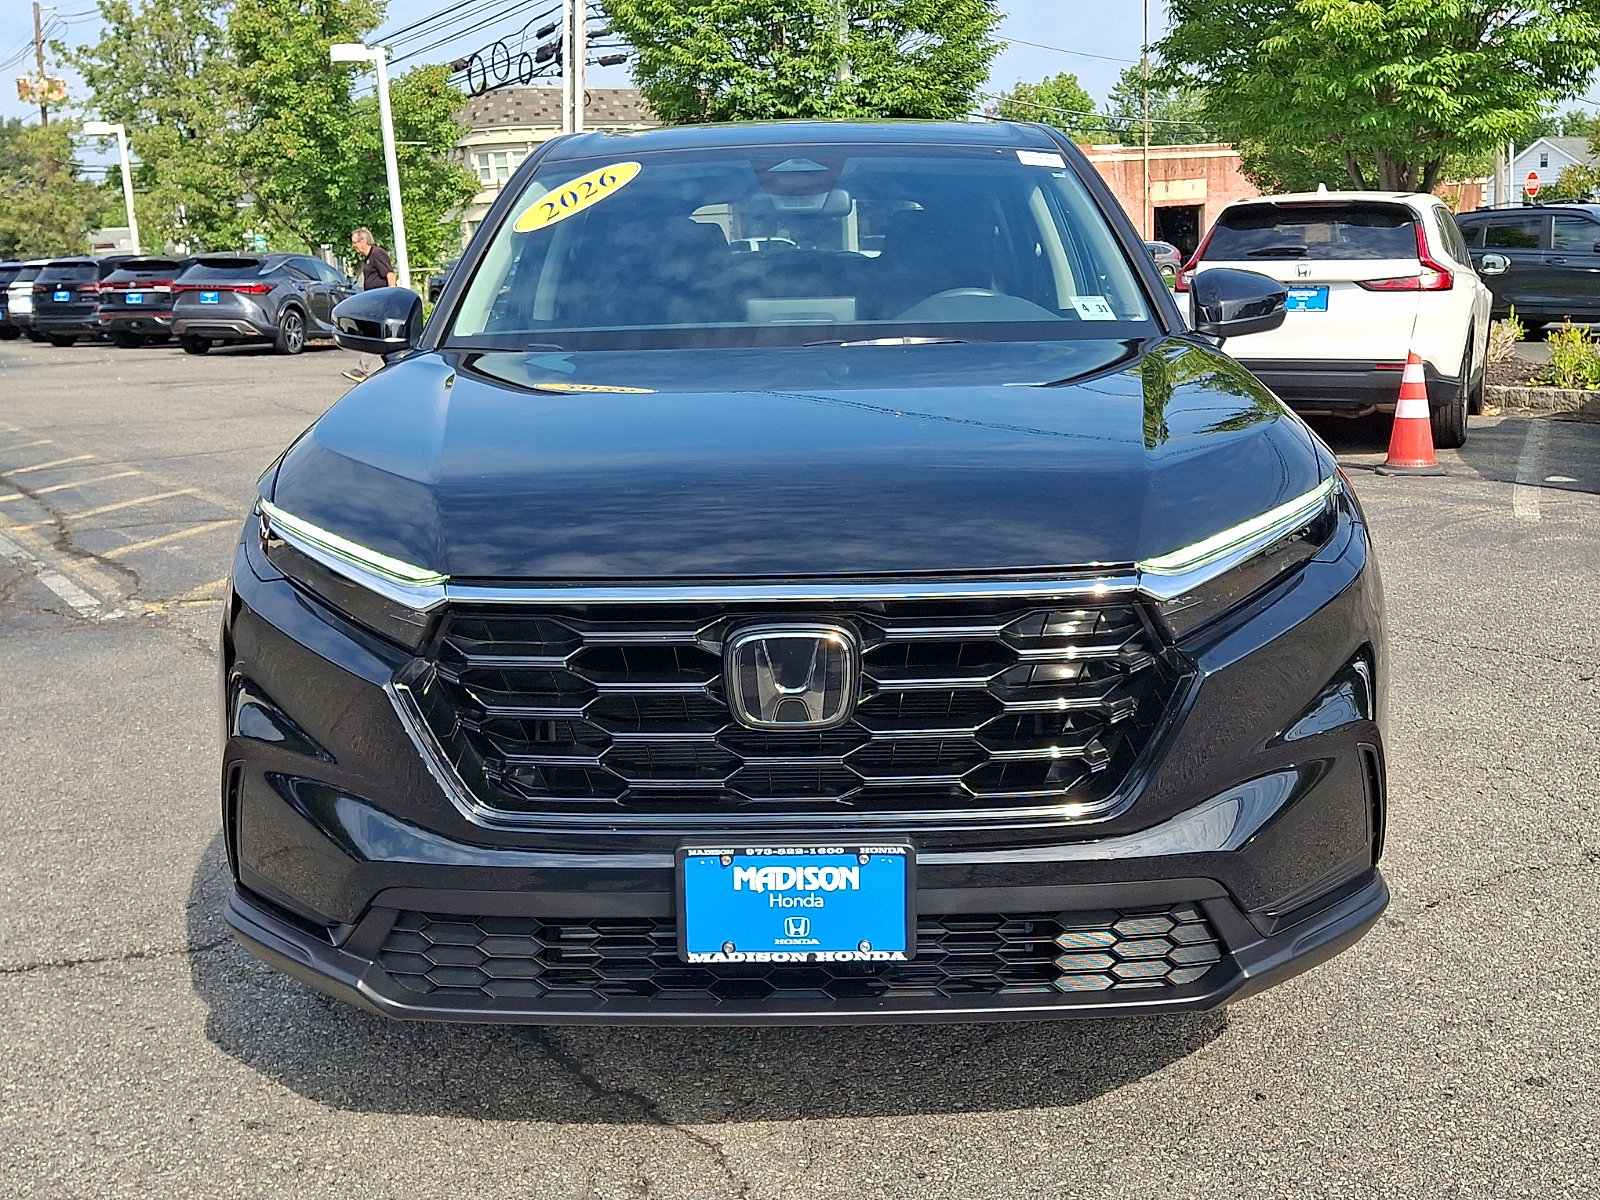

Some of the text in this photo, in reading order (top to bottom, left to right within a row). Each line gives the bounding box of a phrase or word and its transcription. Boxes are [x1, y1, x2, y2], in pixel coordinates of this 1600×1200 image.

[539, 170, 617, 222] 2026
[1081, 303, 1109, 313] 4 31
[859, 847, 907, 855] HONDA
[733, 866, 860, 893] MADISON
[769, 892, 824, 908] Honda
[687, 951, 908, 963] MADISON HONDA
